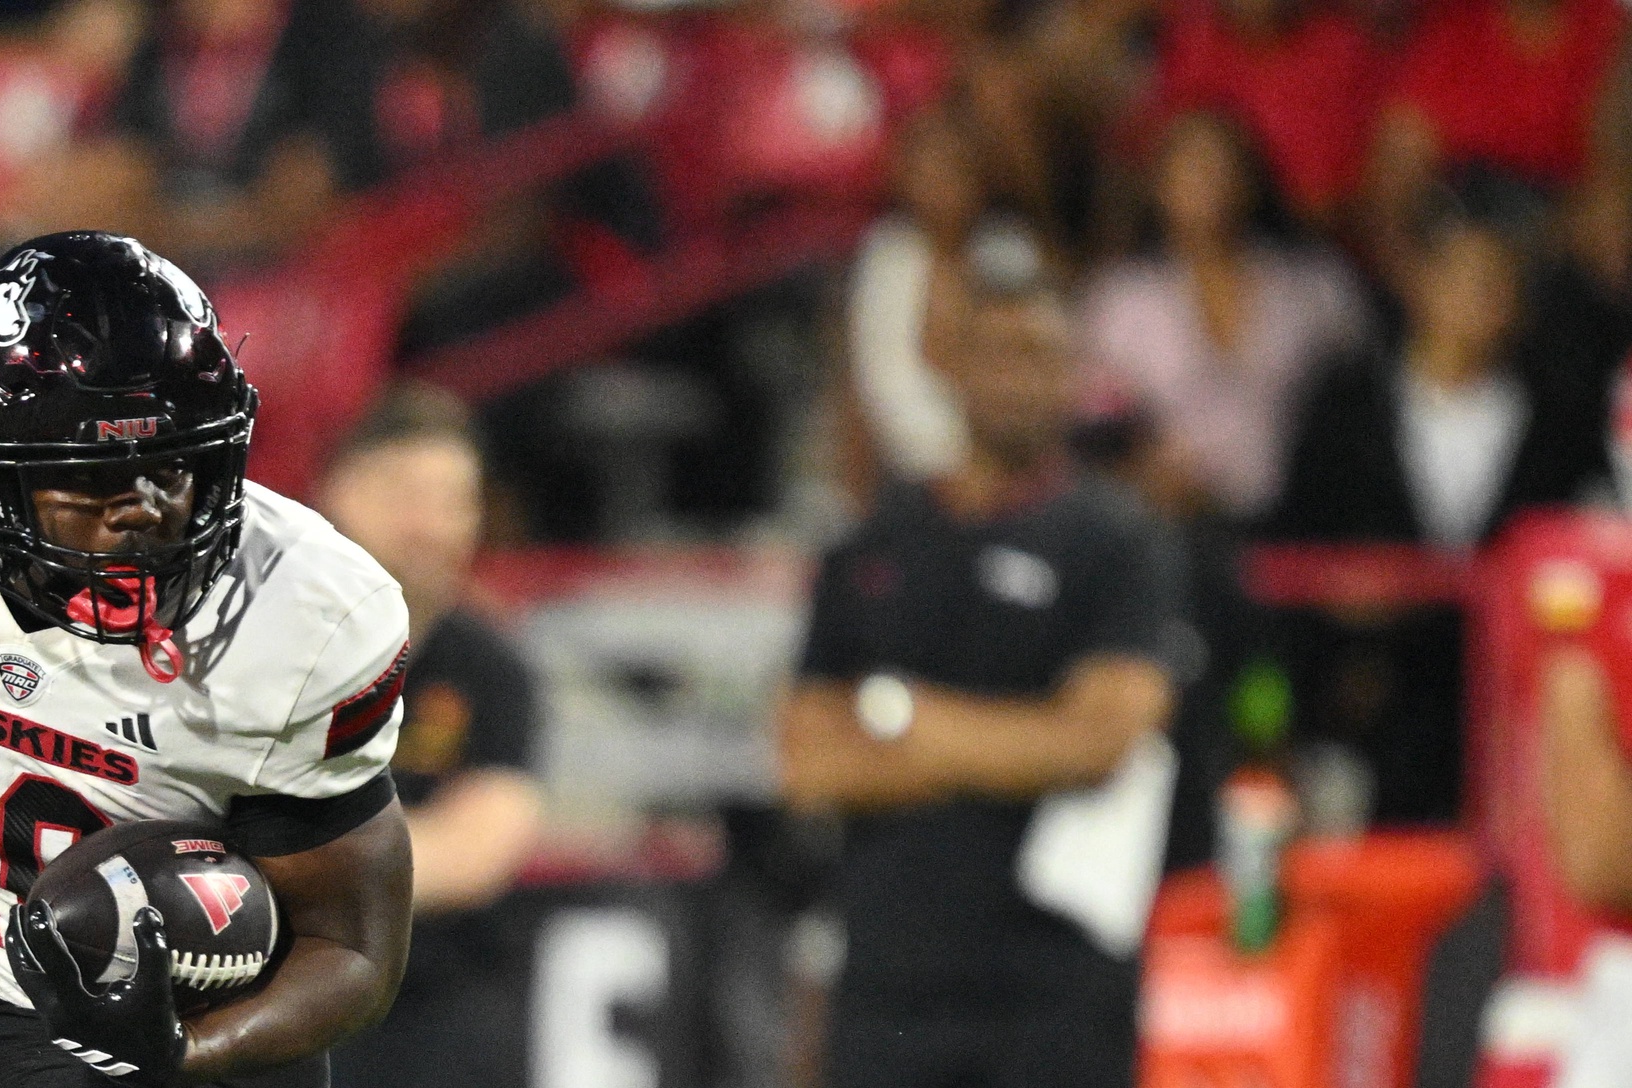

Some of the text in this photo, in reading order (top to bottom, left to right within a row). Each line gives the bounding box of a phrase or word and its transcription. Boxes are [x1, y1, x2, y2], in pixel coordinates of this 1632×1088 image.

[97, 417, 157, 441] NIU
[3, 655, 39, 671] GRADUATE
[1, 672, 36, 689] MAC
[171, 839, 226, 854] DIME
